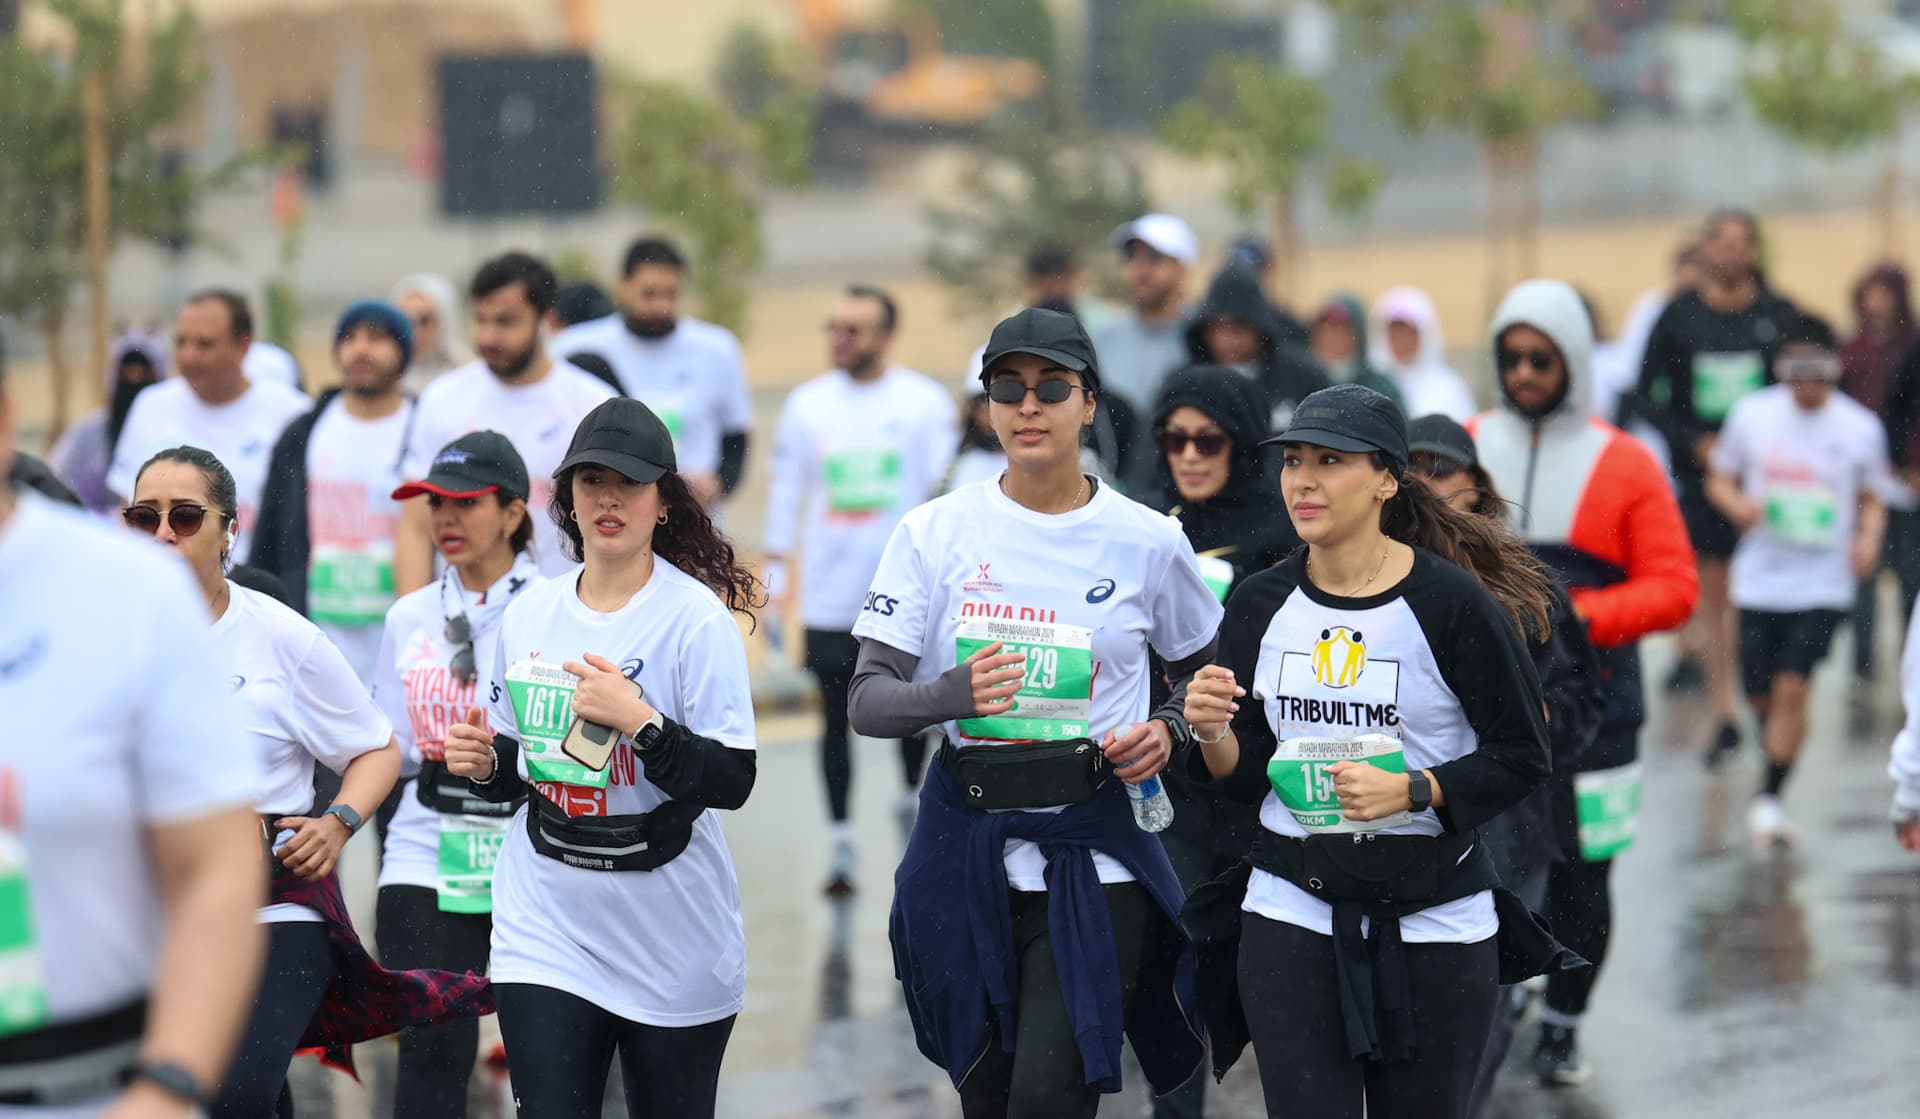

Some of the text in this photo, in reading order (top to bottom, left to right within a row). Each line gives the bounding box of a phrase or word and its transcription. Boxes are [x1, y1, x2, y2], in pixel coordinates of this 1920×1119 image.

[987, 622, 1008, 634] RIYADH
[1009, 624, 1040, 637] MARATHON
[1298, 742, 1317, 753] RIYADH
[1318, 742, 1349, 753] MARATHON
